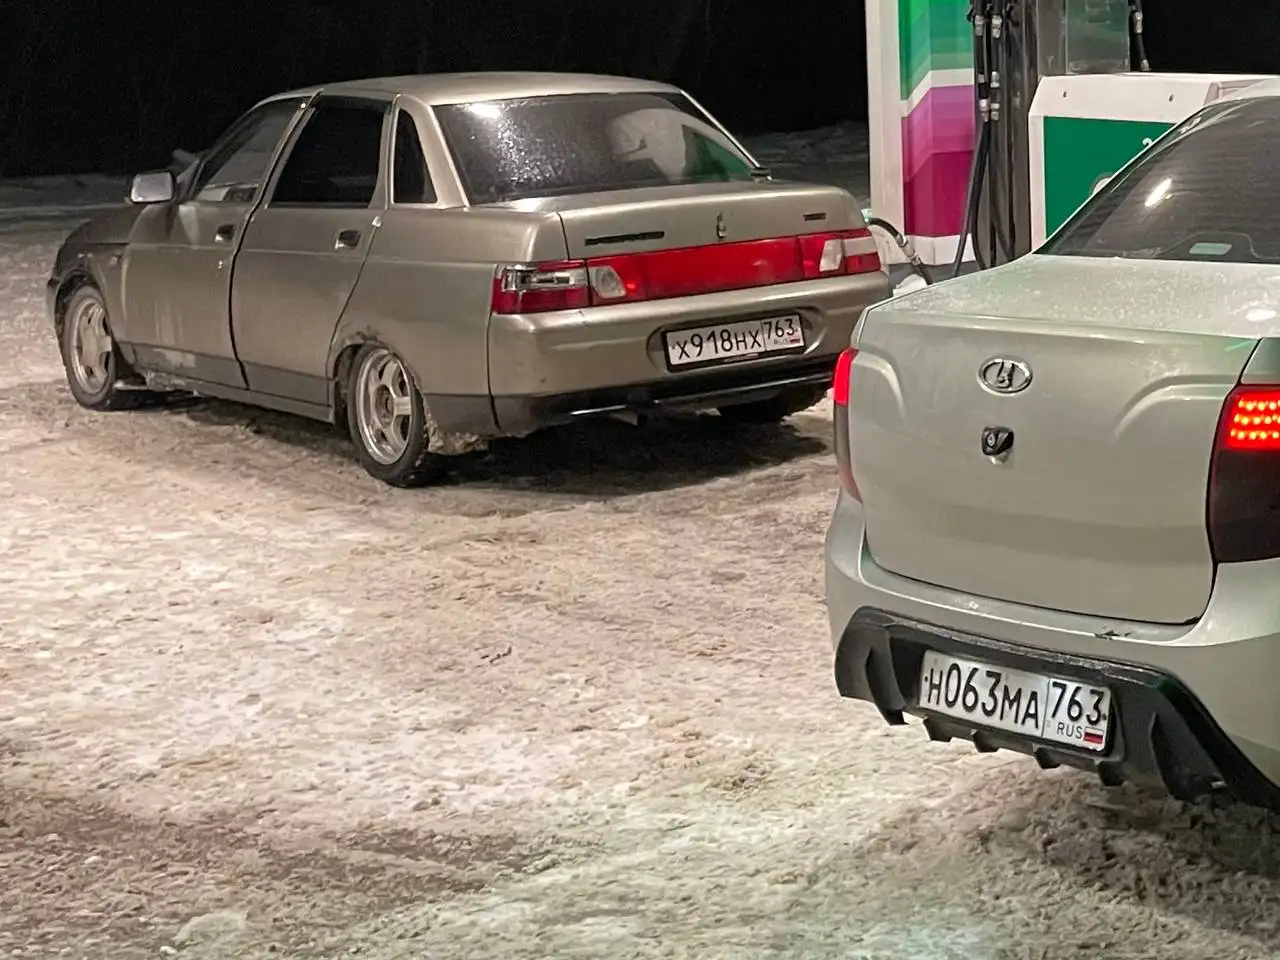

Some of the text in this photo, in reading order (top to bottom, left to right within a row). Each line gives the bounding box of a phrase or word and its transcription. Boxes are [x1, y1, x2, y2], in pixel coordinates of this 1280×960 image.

[676, 318, 796, 361] Х918НХ 763
[927, 662, 1105, 730] Н063МА 763
[1056, 721, 1083, 740] RUS
